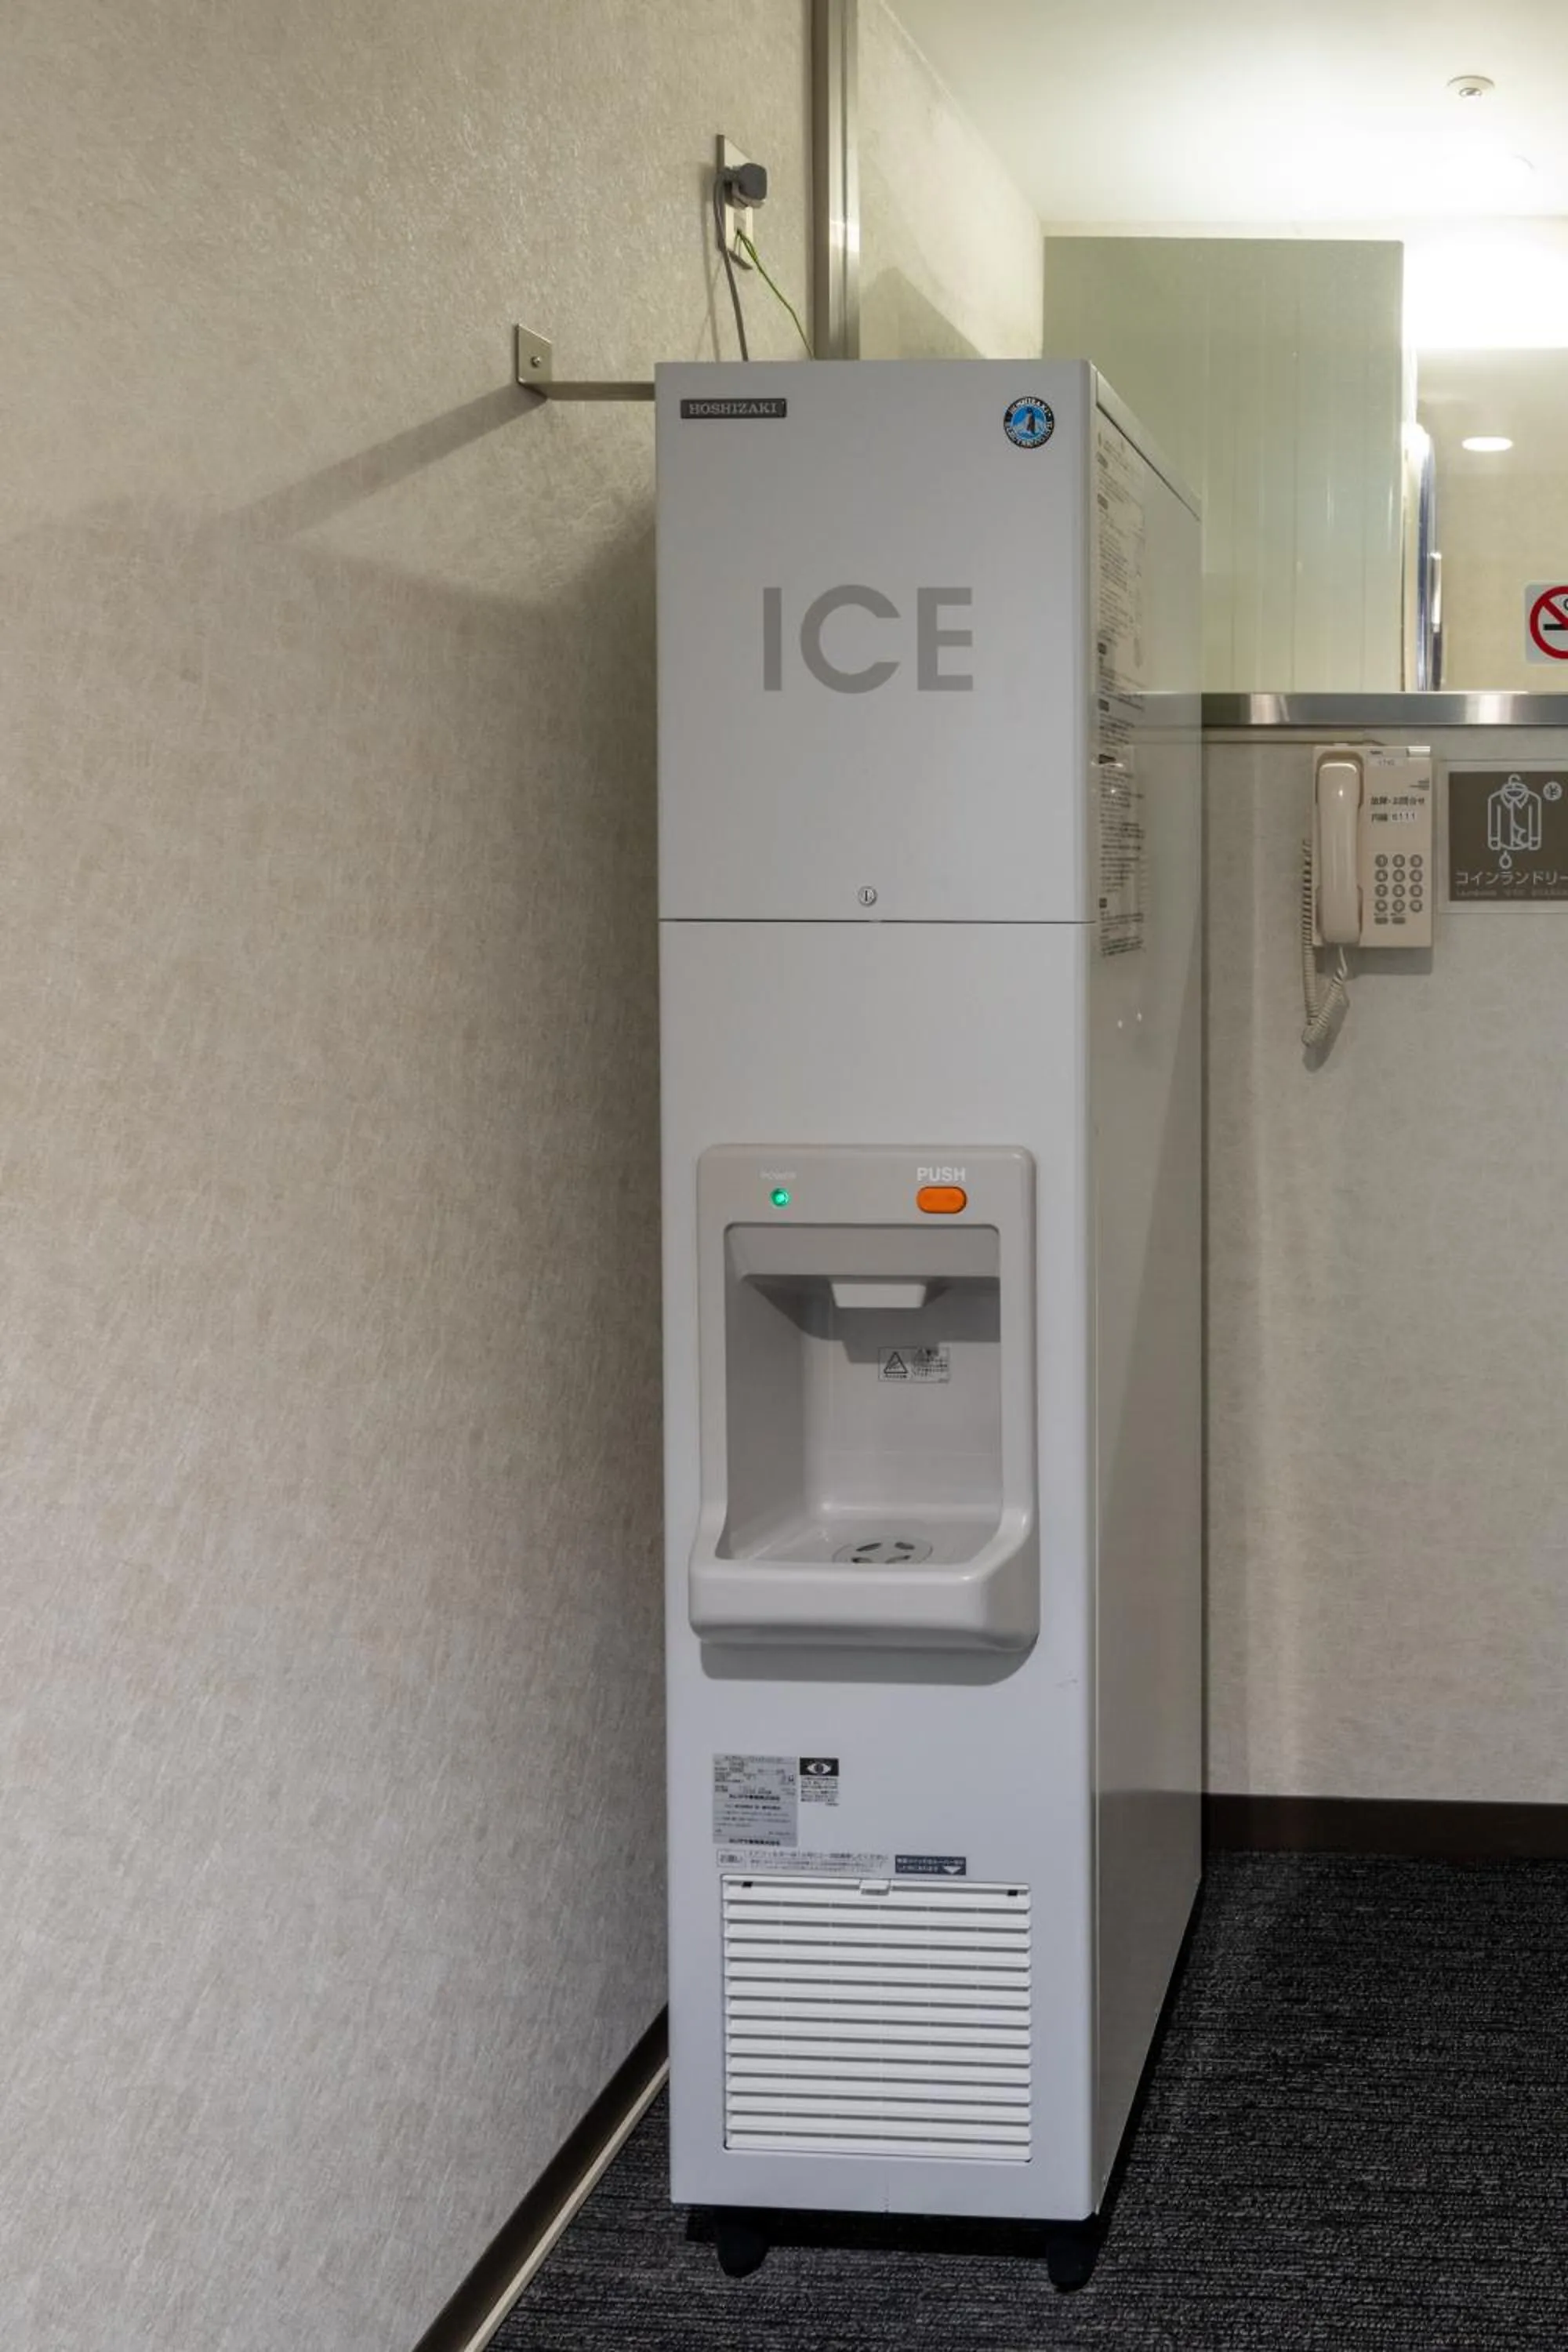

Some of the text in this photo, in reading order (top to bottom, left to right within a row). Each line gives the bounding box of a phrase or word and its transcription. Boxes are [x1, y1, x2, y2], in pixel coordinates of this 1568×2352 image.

[689, 401, 778, 415] HOSHIZAKI
[763, 584, 973, 694] ICE
[1455, 871, 1568, 885] コインランドリー
[916, 1167, 966, 1181] PUSH
